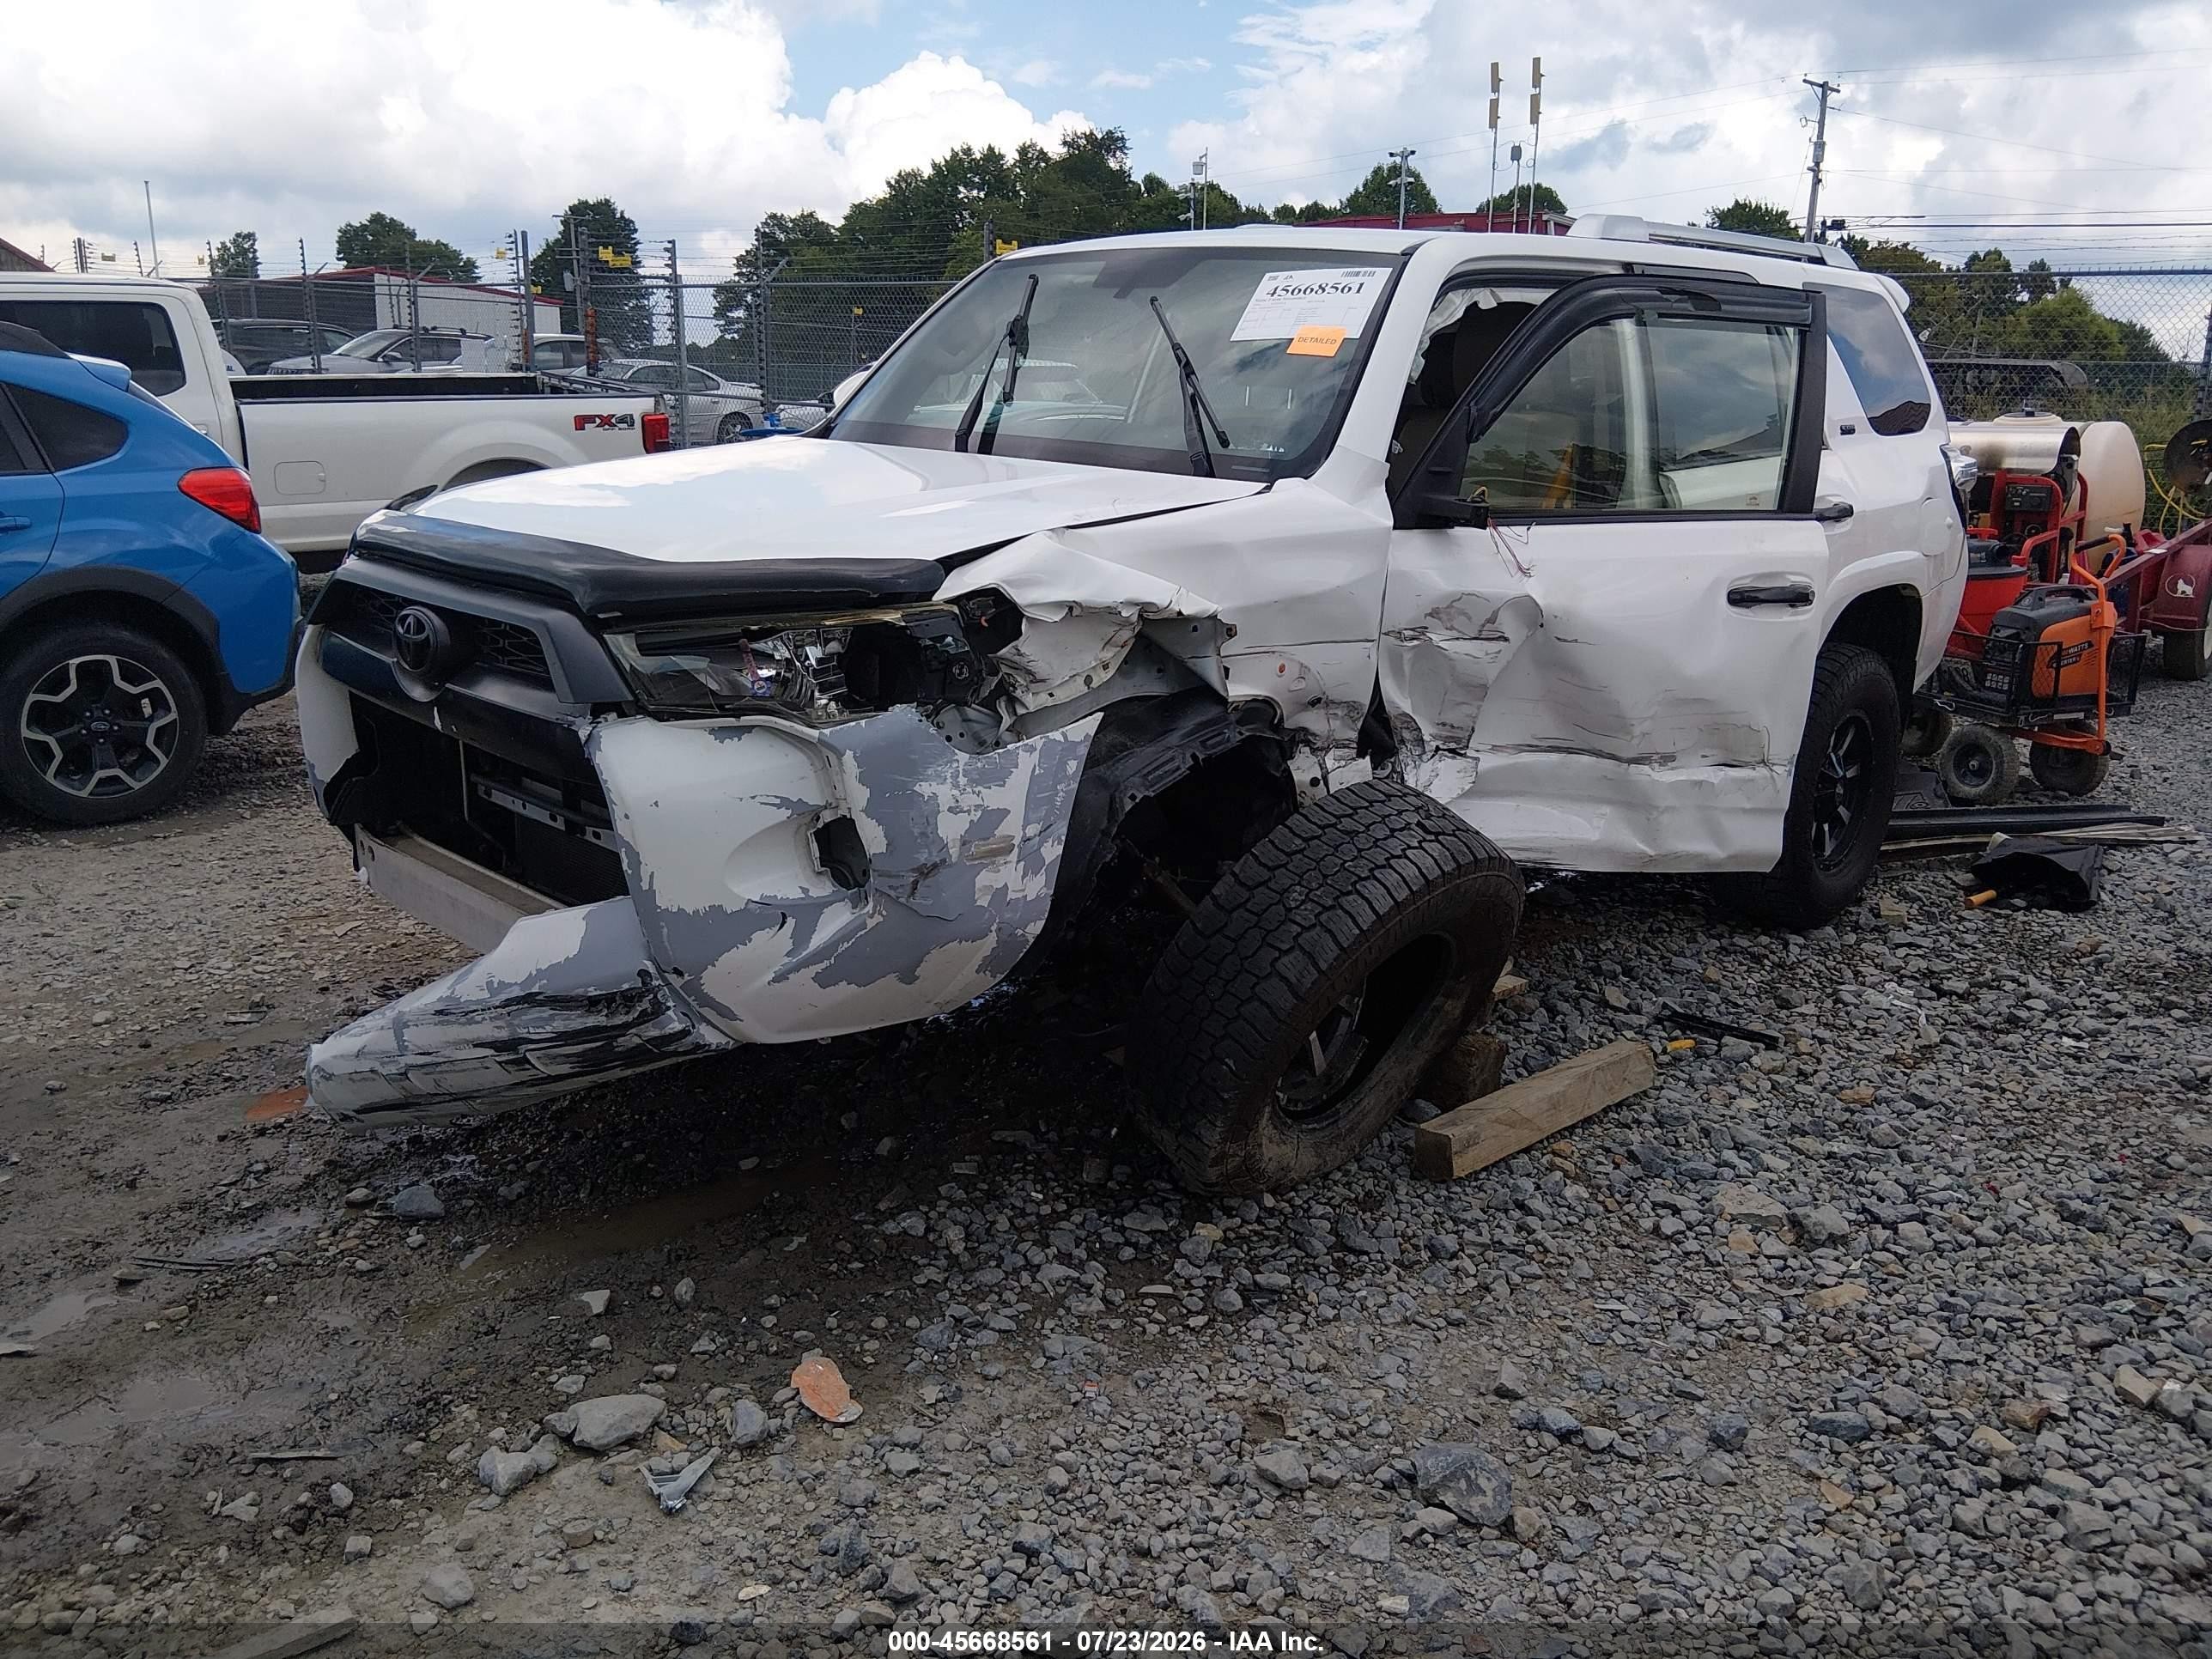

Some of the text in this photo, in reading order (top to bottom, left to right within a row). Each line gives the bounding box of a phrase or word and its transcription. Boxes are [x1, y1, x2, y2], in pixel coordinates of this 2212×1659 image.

[1266, 282, 1365, 298] 45668561
[1297, 336, 1337, 345] DETAILED
[574, 413, 635, 431] FX4
